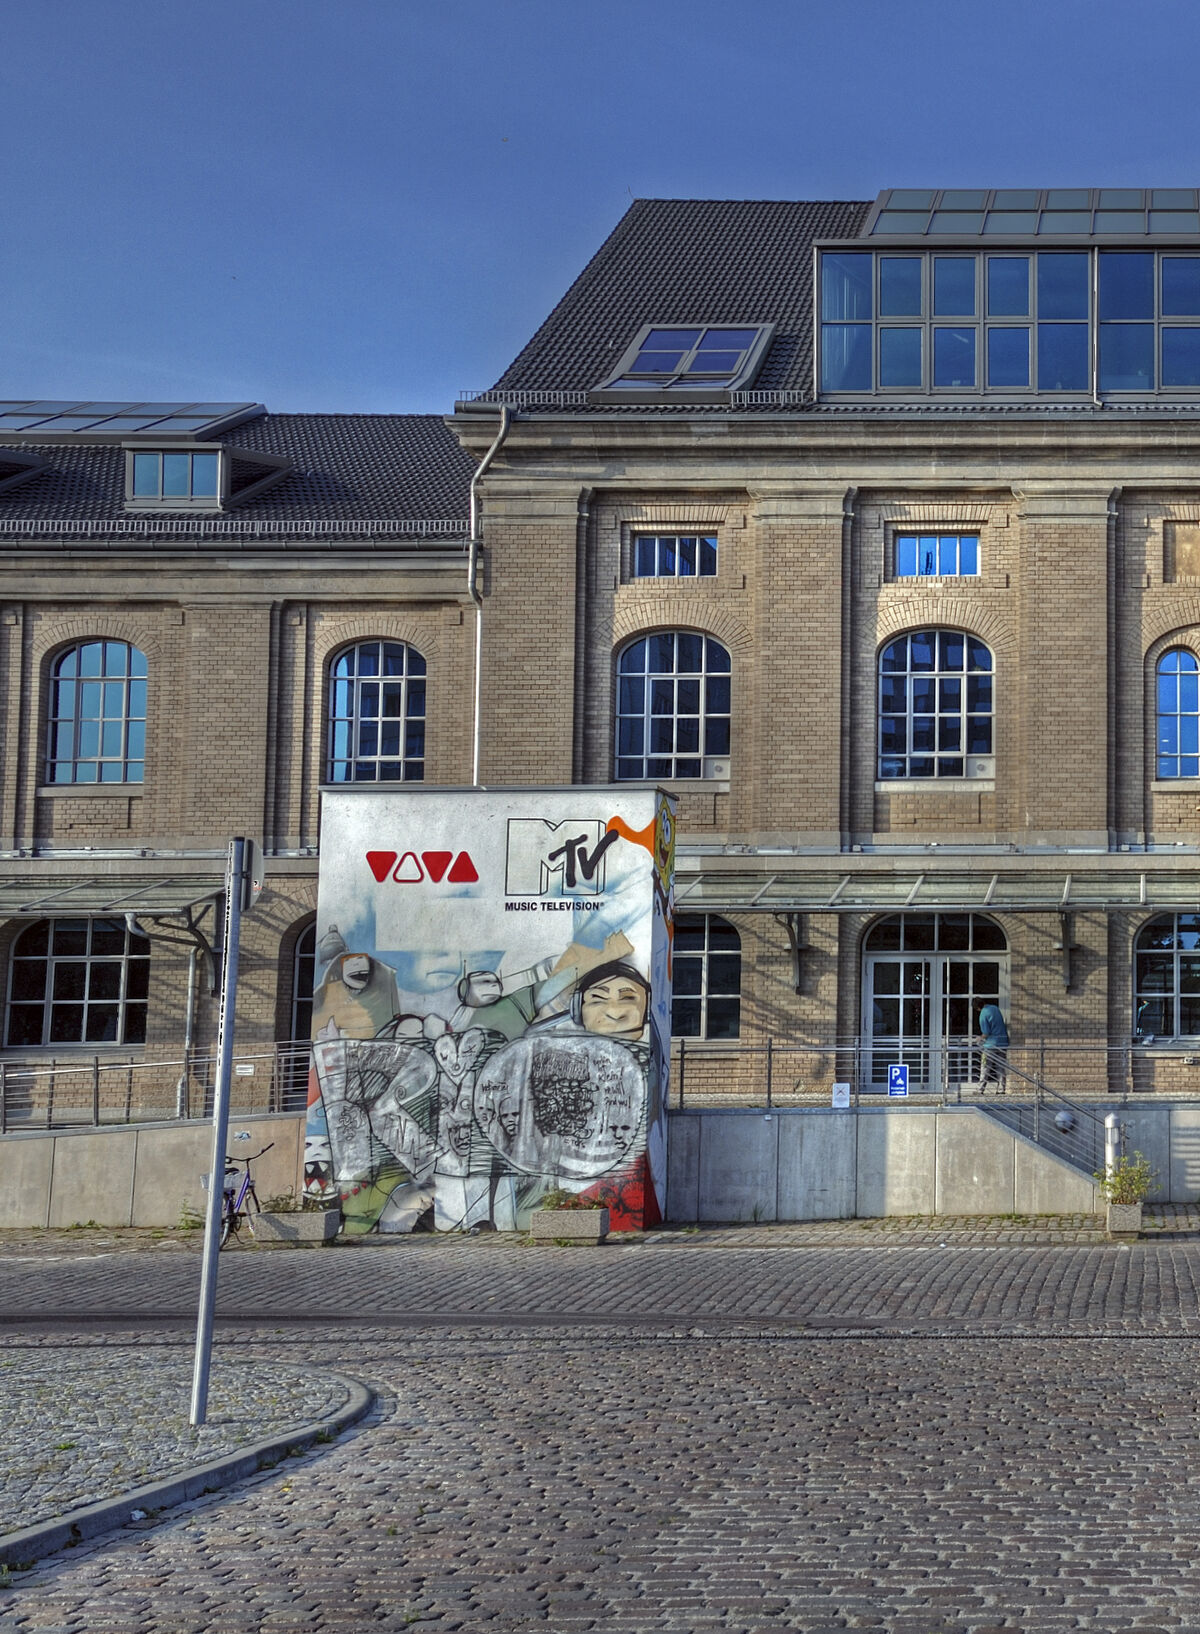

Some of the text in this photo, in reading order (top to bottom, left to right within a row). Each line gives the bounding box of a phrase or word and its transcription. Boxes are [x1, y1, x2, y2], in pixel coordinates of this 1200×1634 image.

[505, 818, 619, 896] MTV
[505, 902, 538, 911] MUSIC
[892, 1068, 900, 1080] P
